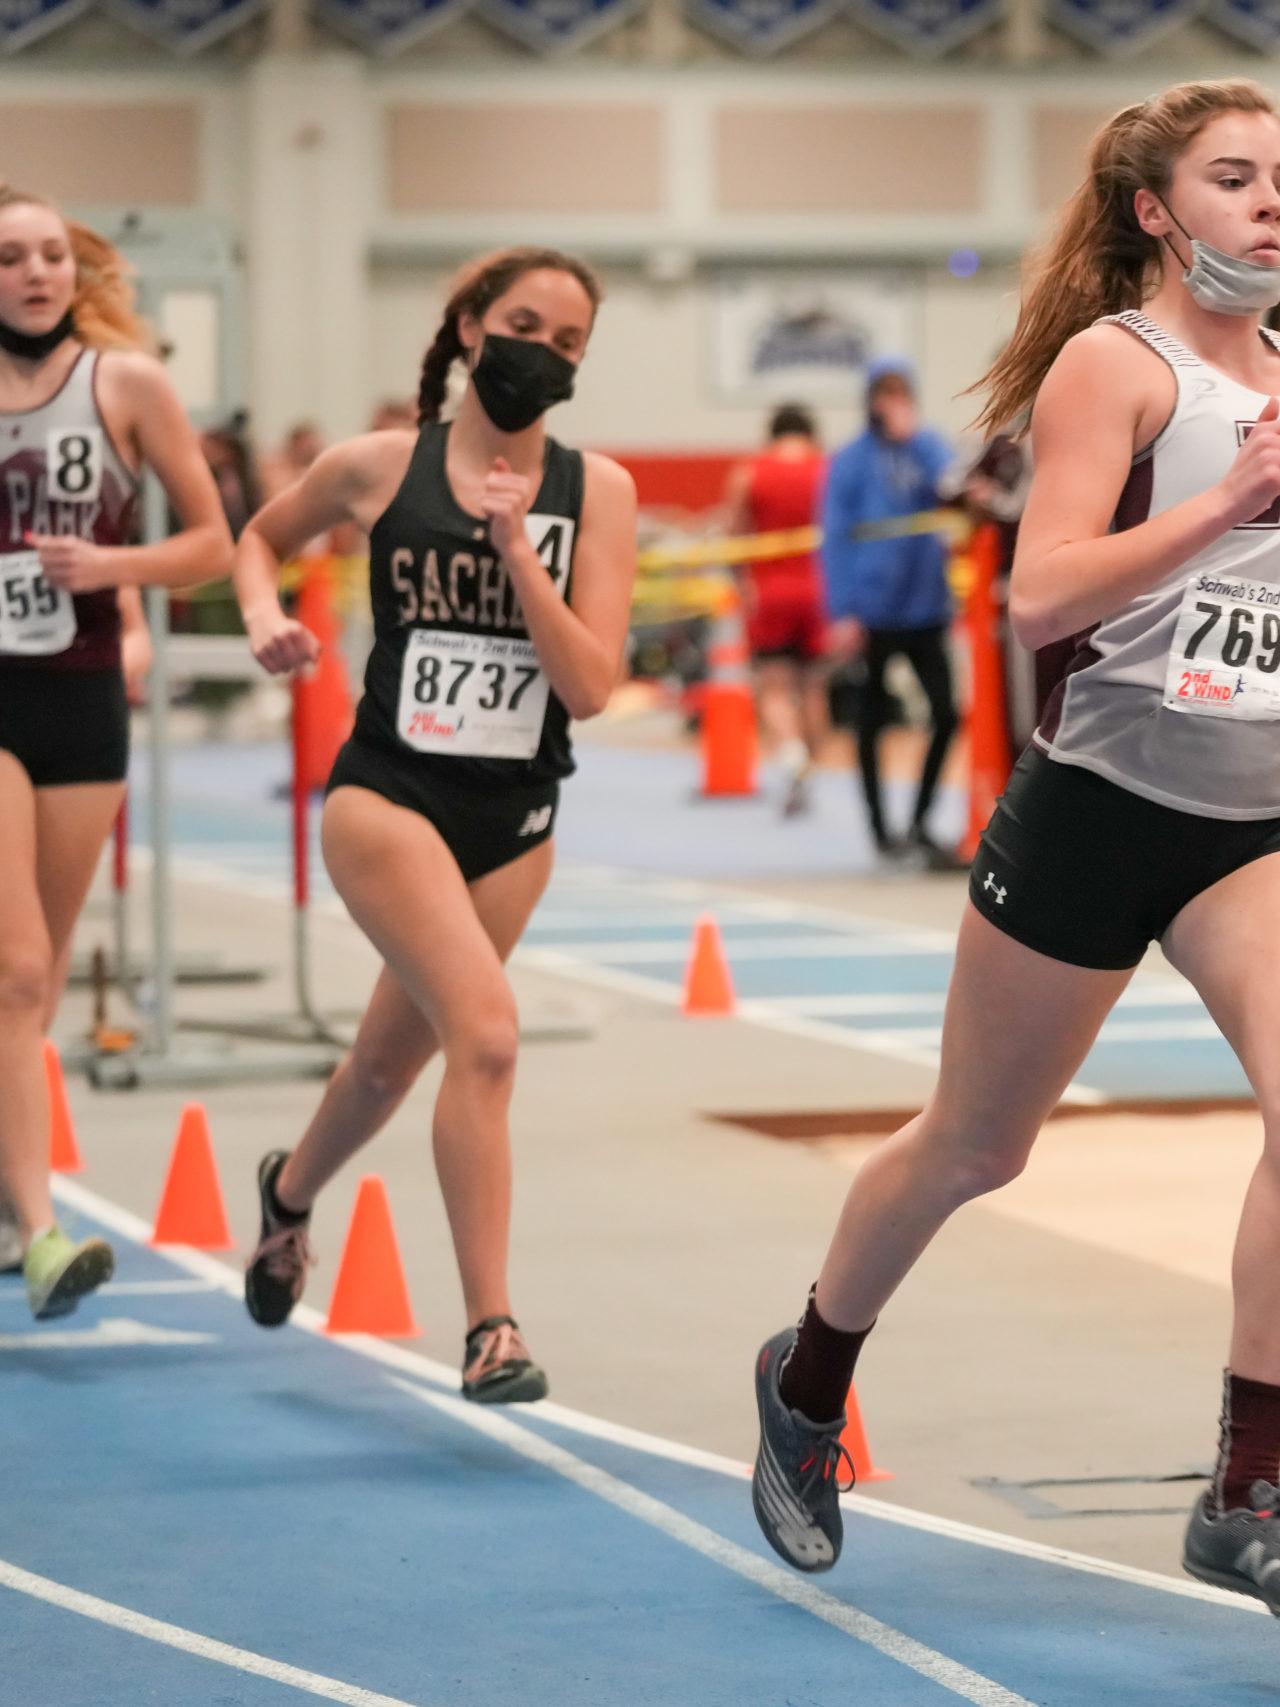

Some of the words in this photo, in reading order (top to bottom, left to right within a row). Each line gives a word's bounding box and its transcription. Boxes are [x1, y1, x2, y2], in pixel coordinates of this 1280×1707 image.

[57, 436, 92, 494] 8
[536, 523, 565, 579] 4
[0, 574, 59, 620] 55
[1196, 576, 1255, 600] Schwab's
[510, 642, 537, 658] Win
[414, 655, 541, 712] 8737
[1193, 682, 1232, 701] WIND
